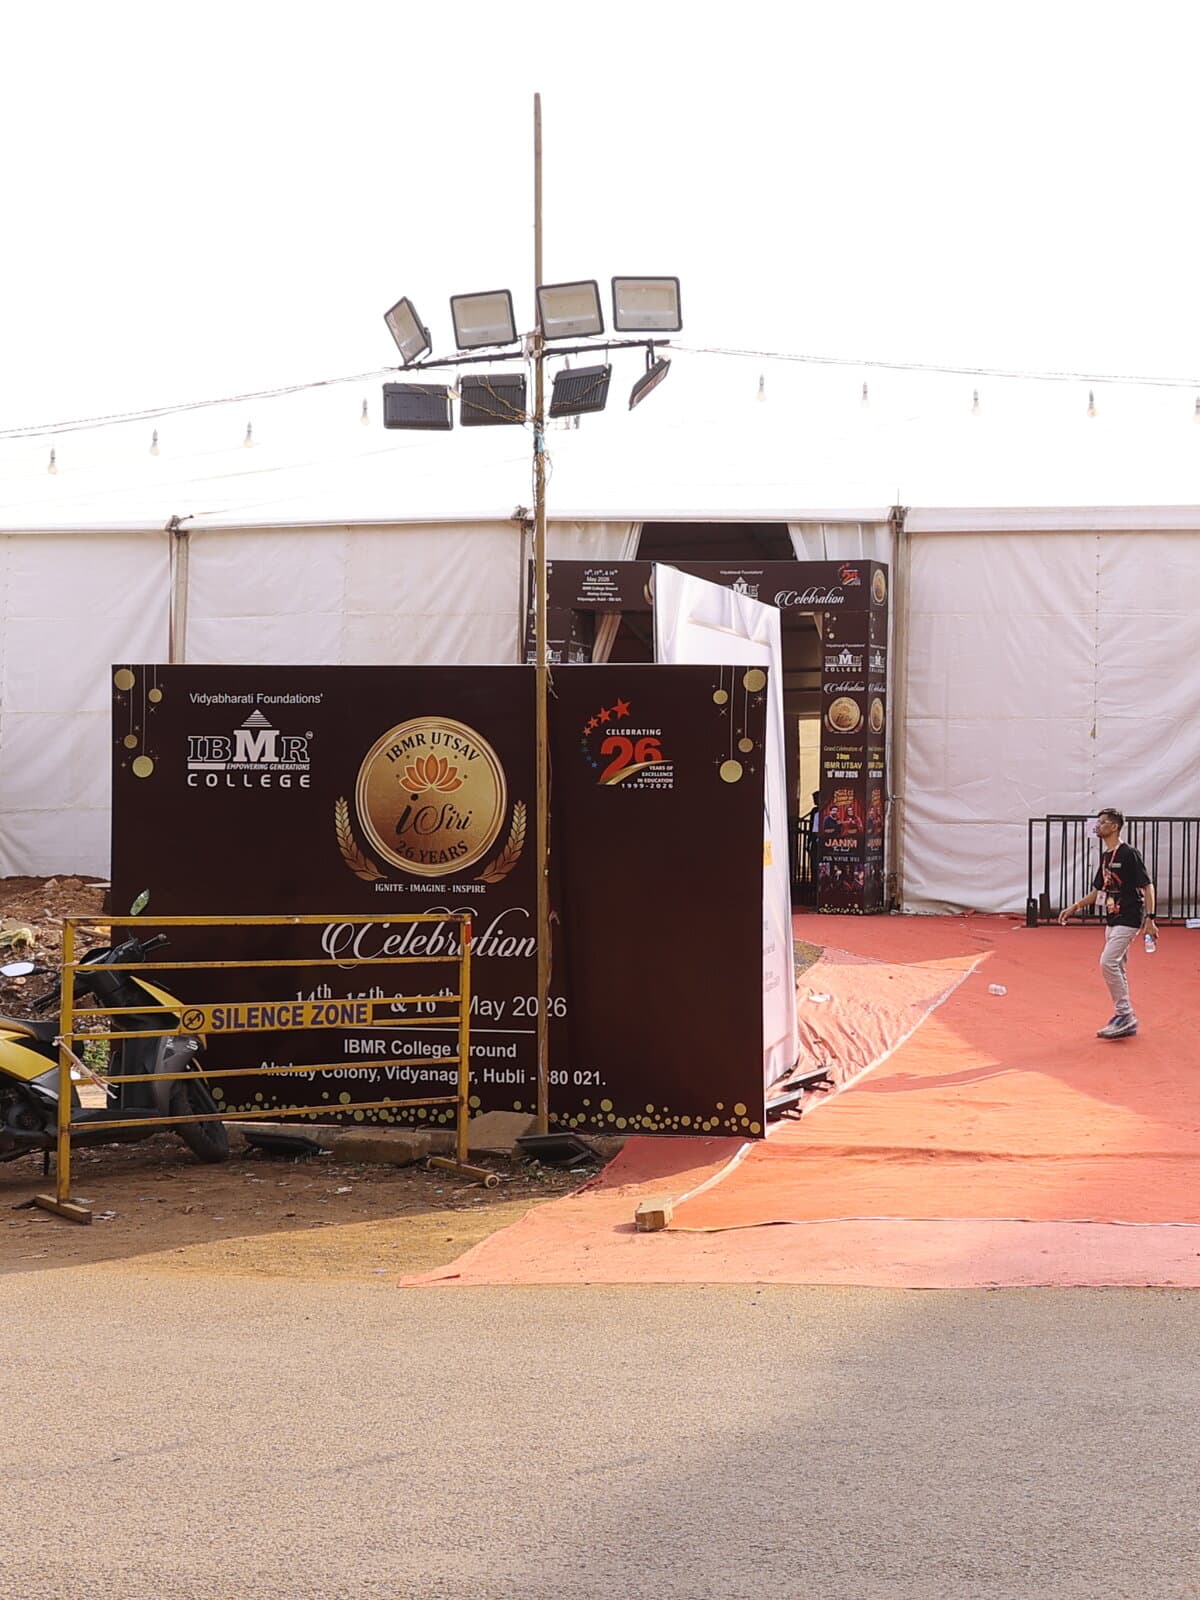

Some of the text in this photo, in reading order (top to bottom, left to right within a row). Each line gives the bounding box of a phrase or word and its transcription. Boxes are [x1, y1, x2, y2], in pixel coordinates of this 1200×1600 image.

[774, 587, 845, 609] Celebration
[190, 693, 323, 706] Vidyabharati Foundations'
[187, 730, 310, 763] IBMR
[386, 732, 480, 763] IBMR UTSAV
[600, 736, 663, 784] 26
[187, 774, 310, 788] COLLEGE
[395, 840, 469, 864] 26 YEARS
[375, 884, 404, 892] IGNITE
[410, 884, 446, 893] IMAGINE
[452, 885, 486, 893] INSPIRE
[211, 1003, 368, 1030] SILENCE ZONE
[344, 1039, 386, 1054] IBMR
[391, 1041, 451, 1059] College
[384, 1066, 478, 1084] Vidyanagr,
[483, 1068, 525, 1083] Hubli
[547, 1071, 568, 1084] 80
[573, 1071, 607, 1085] 021.
